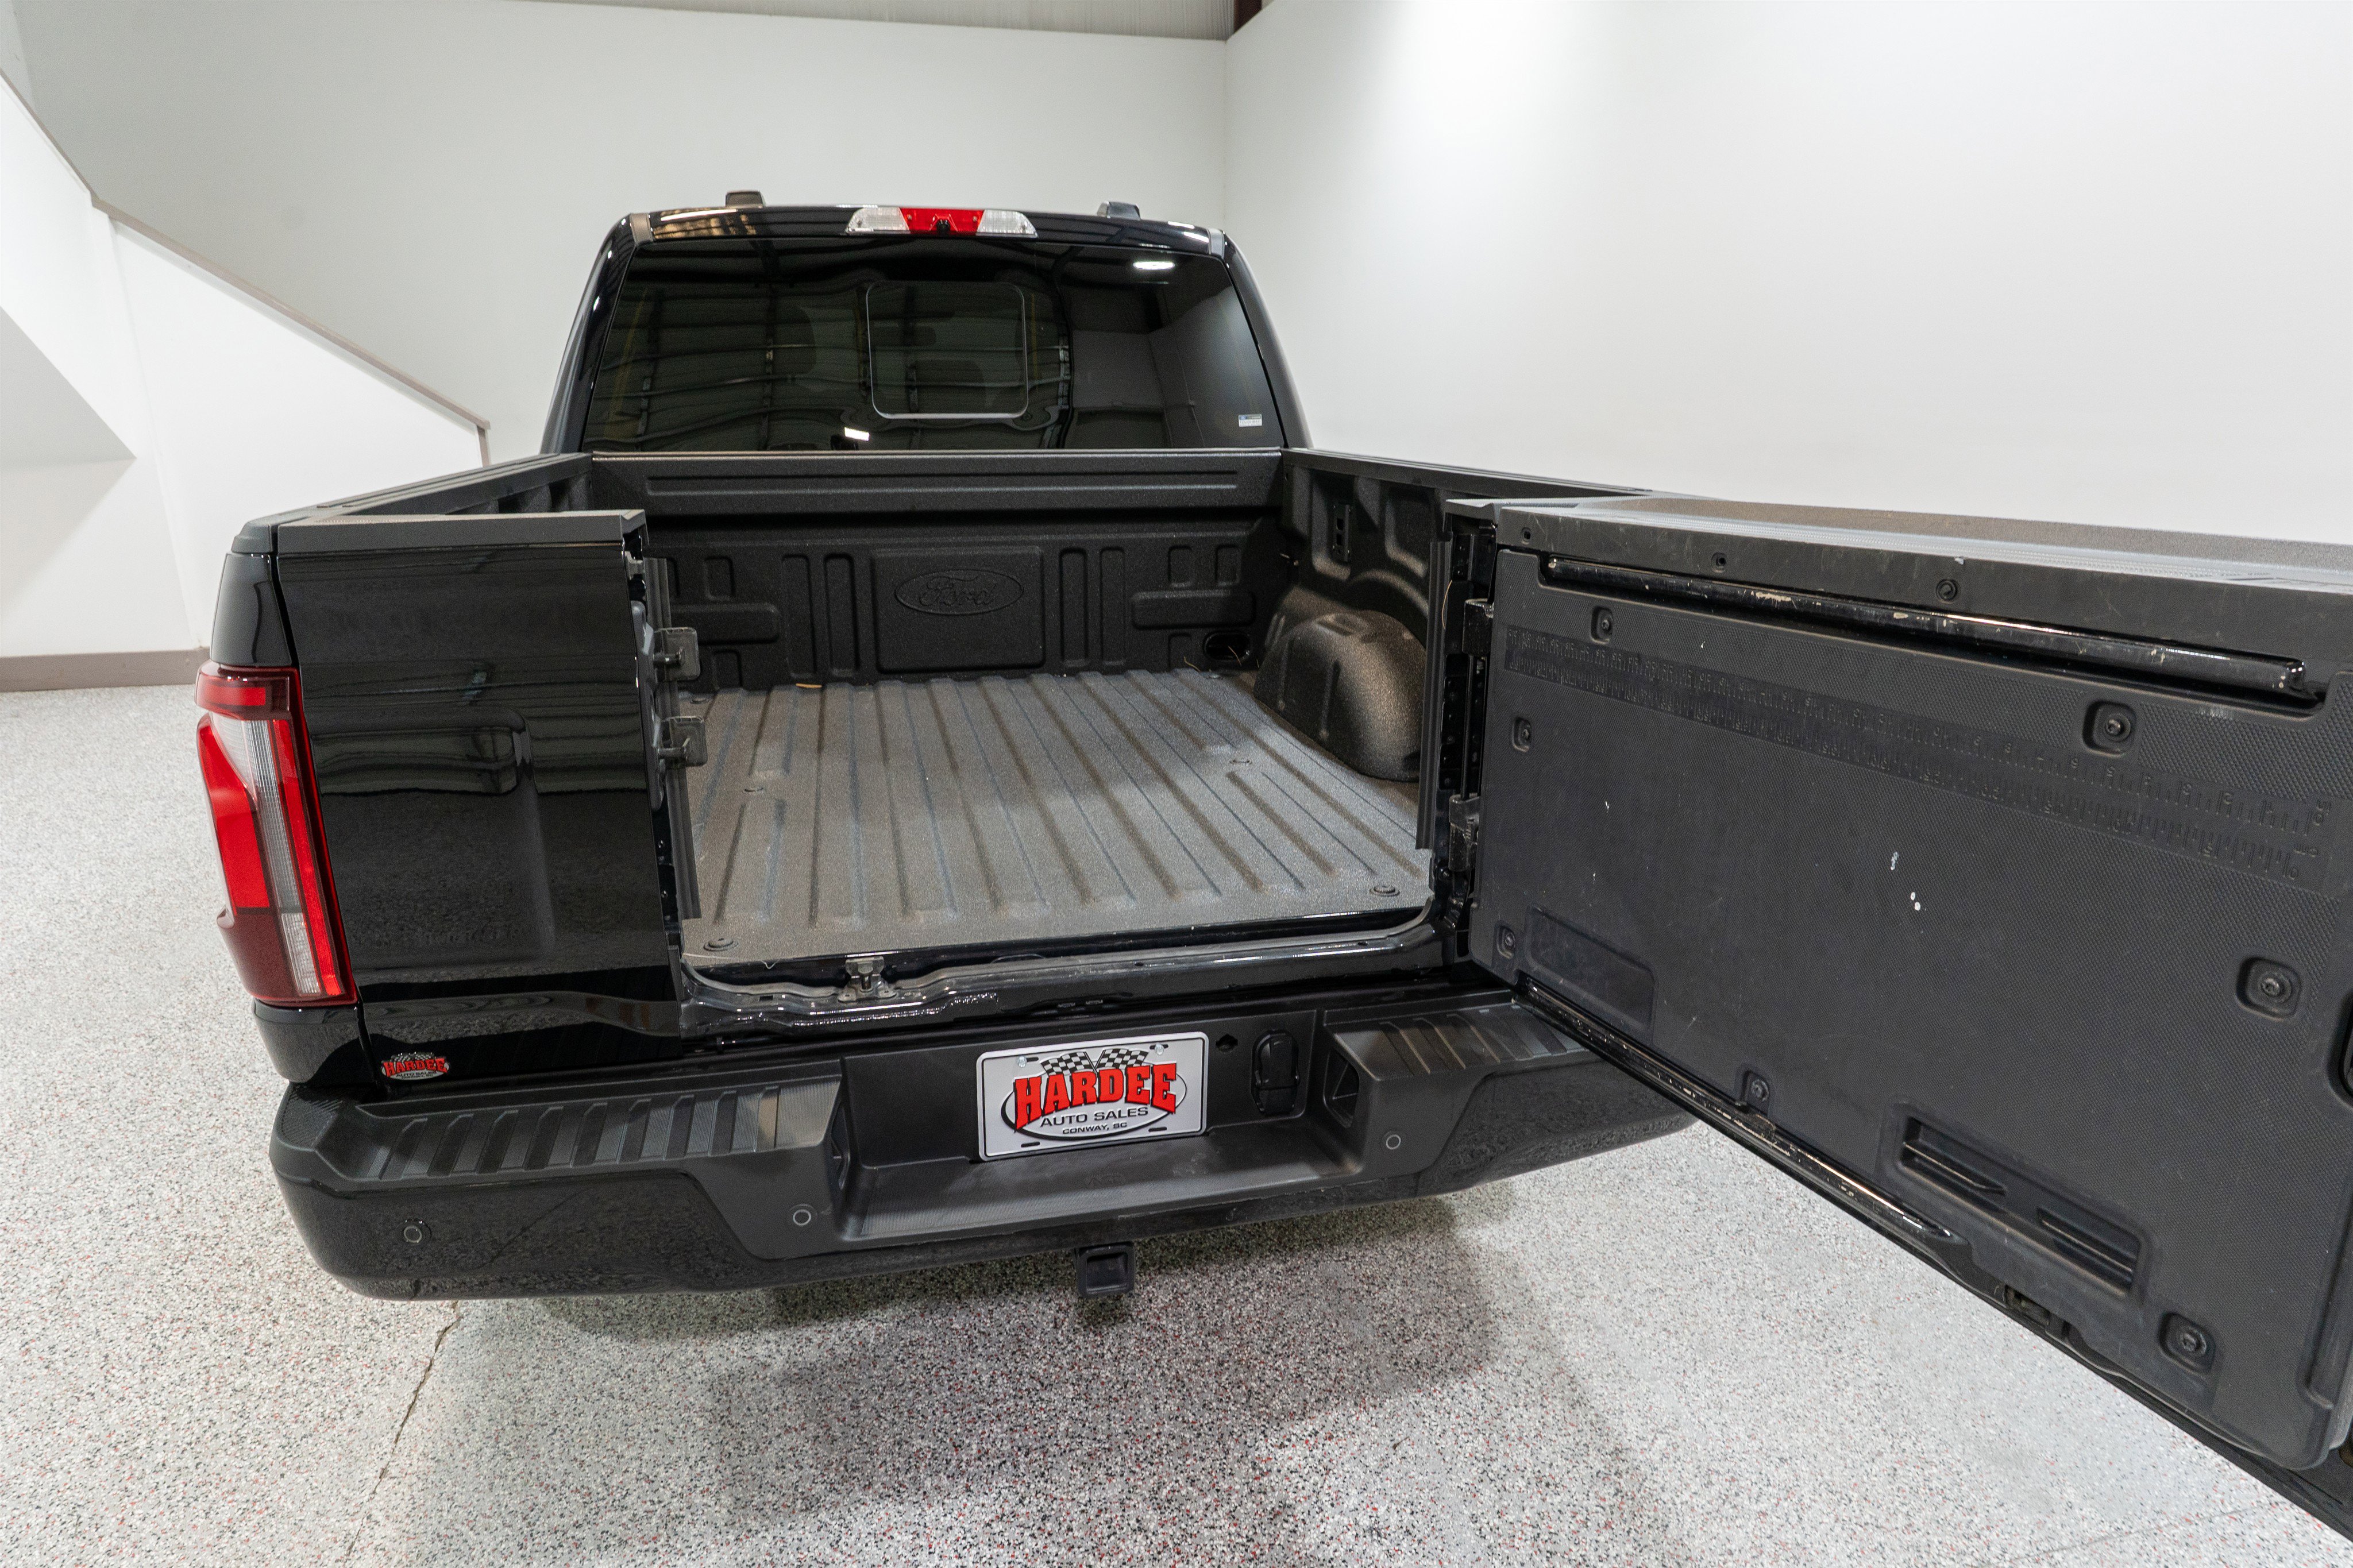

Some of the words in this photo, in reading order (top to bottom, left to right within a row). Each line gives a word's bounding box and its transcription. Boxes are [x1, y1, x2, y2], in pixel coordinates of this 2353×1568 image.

[920, 576, 998, 606] Ford
[383, 1057, 448, 1077] HARDEE
[1013, 1063, 1177, 1132] HARDEE
[1040, 1113, 1088, 1127] AUTO
[1094, 1106, 1149, 1121] SALES
[1062, 1123, 1110, 1135] CONWAY,
